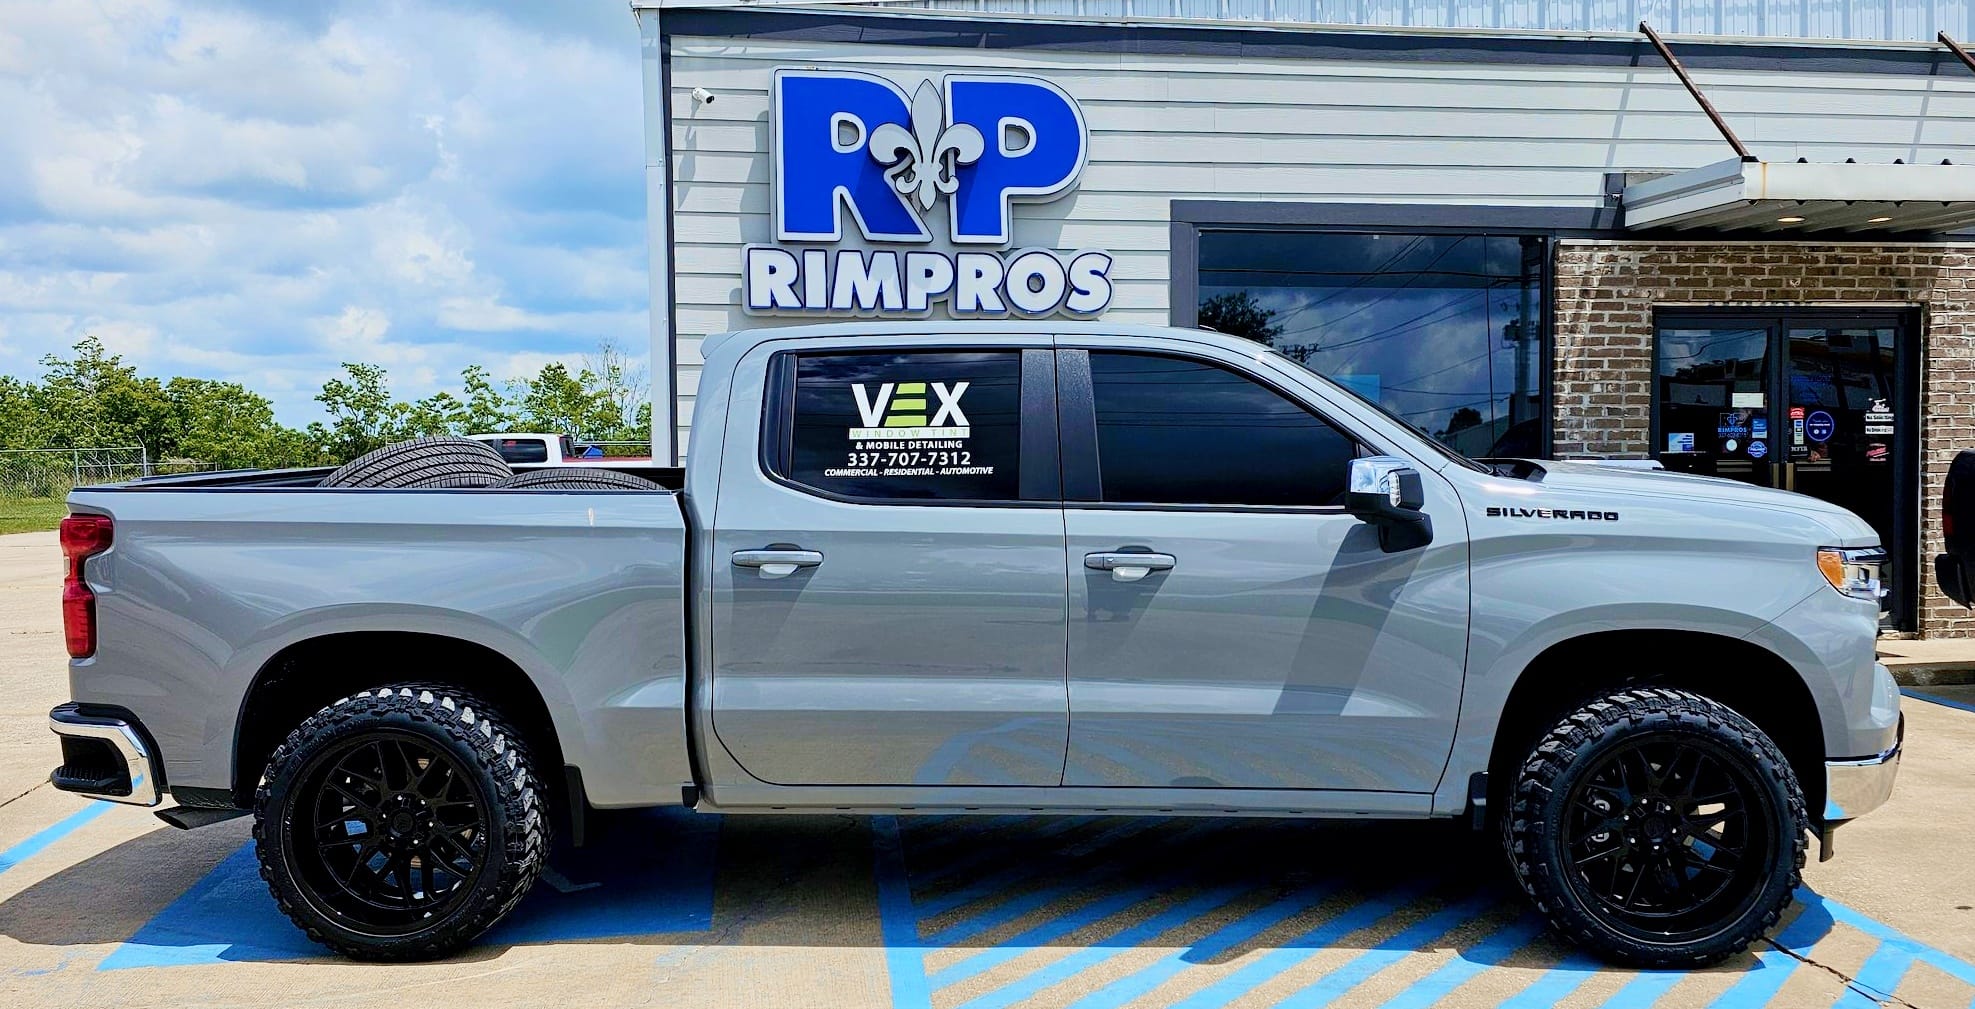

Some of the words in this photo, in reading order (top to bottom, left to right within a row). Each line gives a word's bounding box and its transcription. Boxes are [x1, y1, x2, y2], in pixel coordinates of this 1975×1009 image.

[747, 248, 1113, 313] RIMPROS
[851, 382, 970, 427] VEX
[852, 429, 920, 438] WINDOW
[931, 428, 968, 436] TINT
[855, 442, 863, 450] &
[866, 441, 905, 450] MOBILE
[908, 440, 963, 449] DETAILING
[848, 452, 971, 466] 337-707-7312
[824, 468, 878, 477] COMMERCIAL
[884, 467, 935, 476] RESIDENTIAL
[940, 466, 994, 475] AUTOMOTIVE
[1486, 507, 1619, 521] SILVERADO
